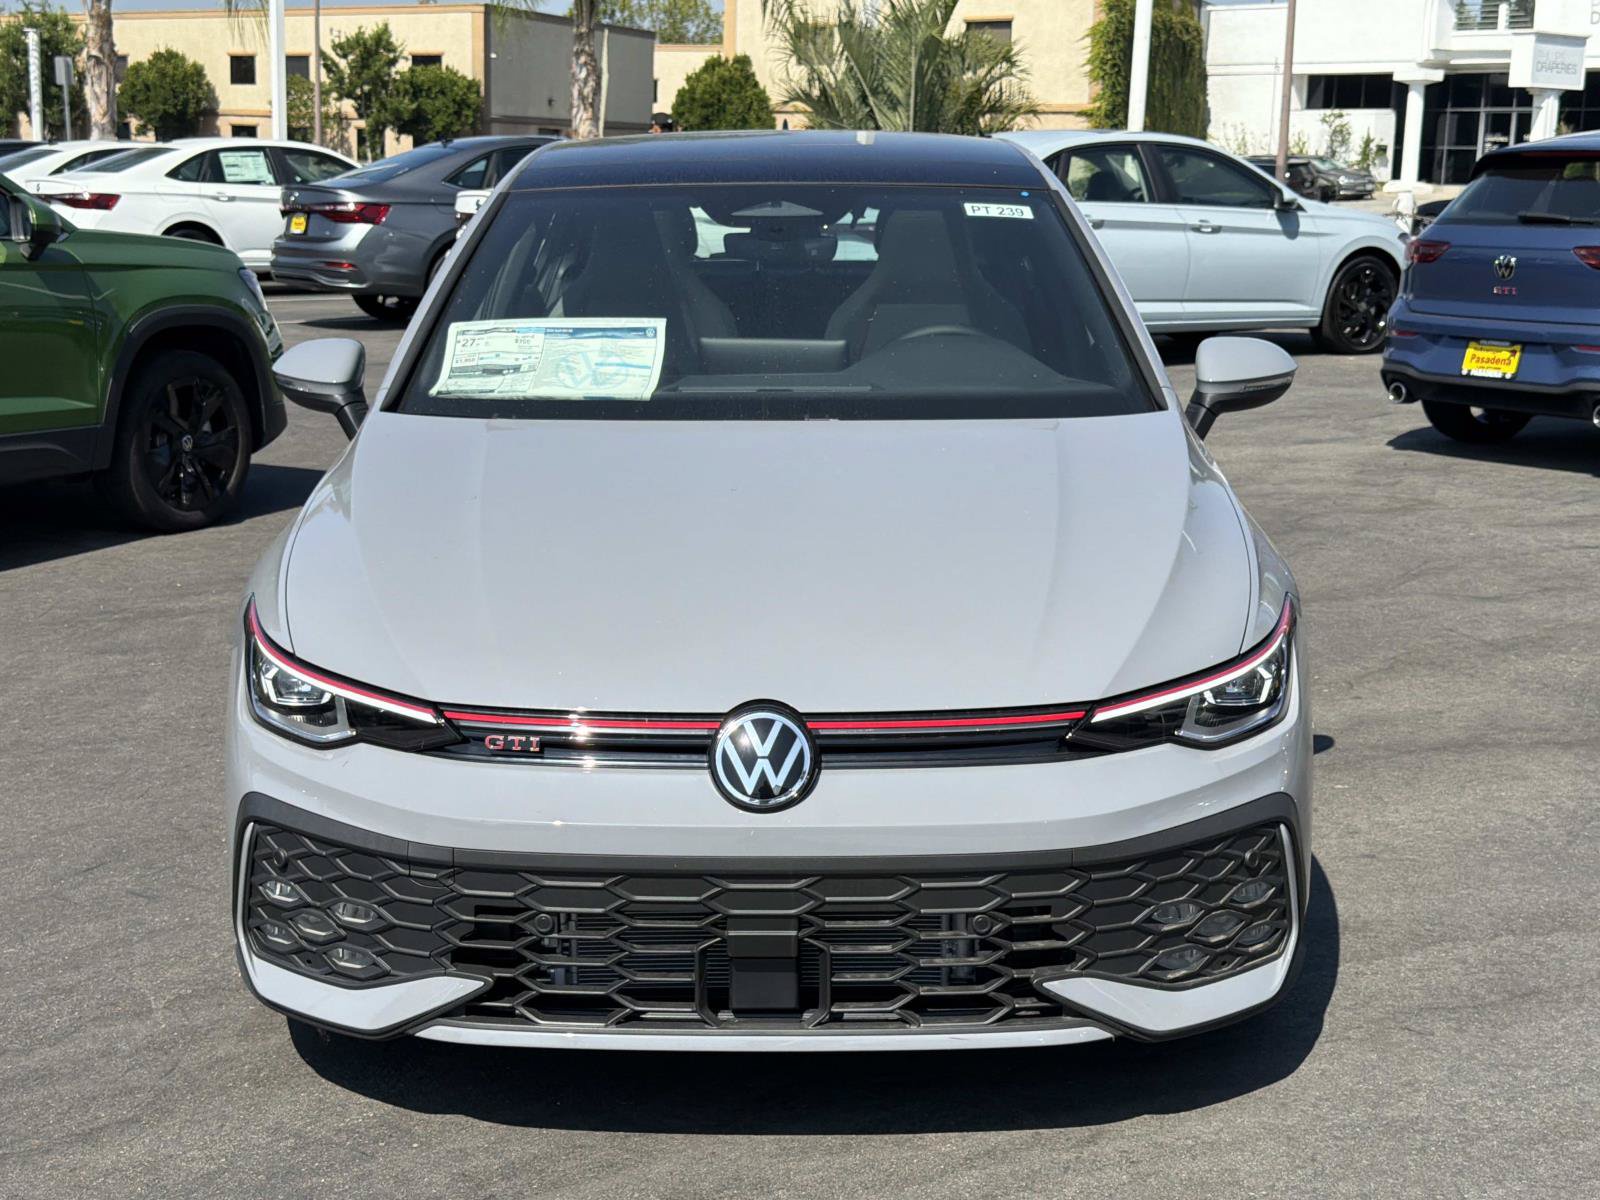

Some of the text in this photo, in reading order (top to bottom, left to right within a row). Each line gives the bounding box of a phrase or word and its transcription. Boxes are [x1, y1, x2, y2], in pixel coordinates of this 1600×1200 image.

[970, 205, 1025, 217] PT 239
[1493, 286, 1517, 295] GTI
[461, 338, 477, 347] 27
[1470, 353, 1512, 367] Pasadena
[484, 735, 542, 752] GTI
[715, 711, 811, 805] VW
